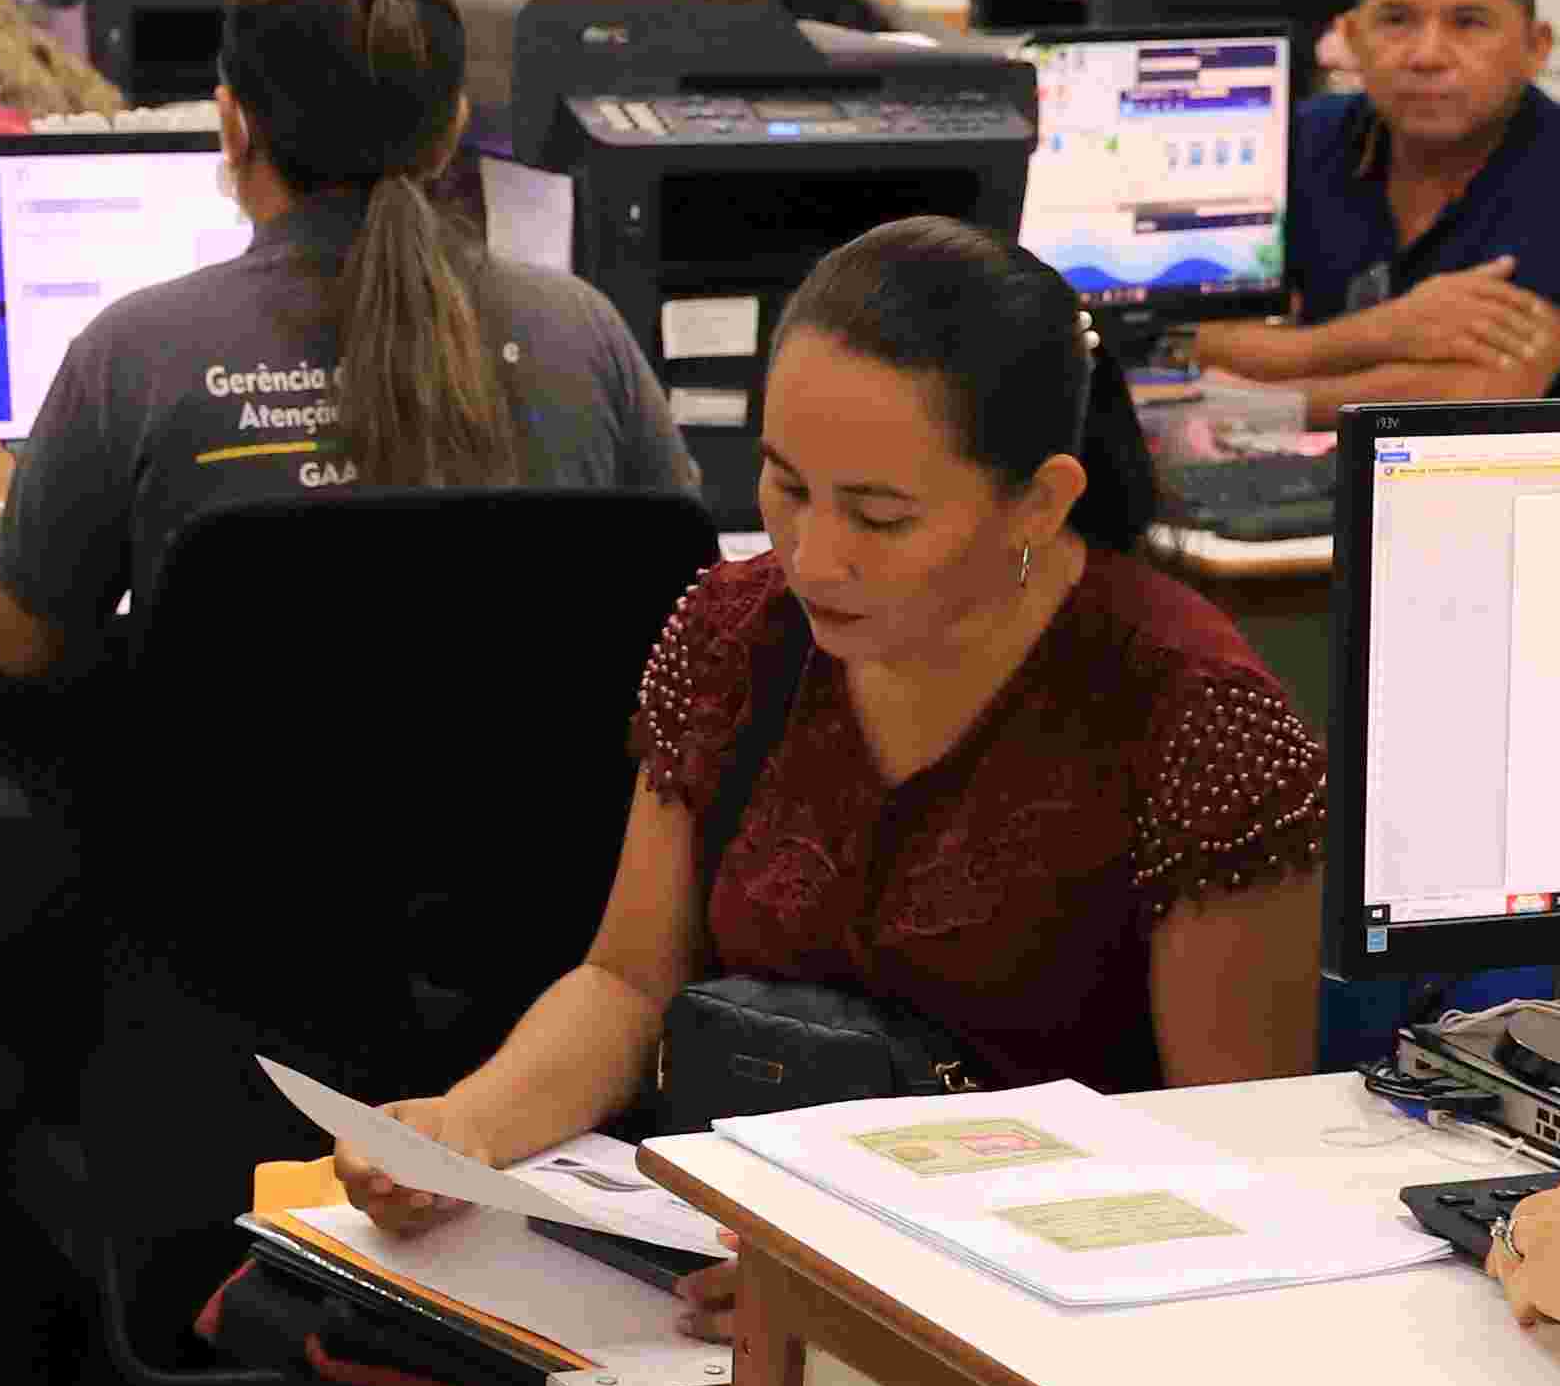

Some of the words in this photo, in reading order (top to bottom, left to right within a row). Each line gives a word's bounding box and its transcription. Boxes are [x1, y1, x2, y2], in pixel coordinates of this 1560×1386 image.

[502, 341, 521, 364] e
[205, 360, 327, 398] Gerência
[298, 461, 359, 489] GAA
